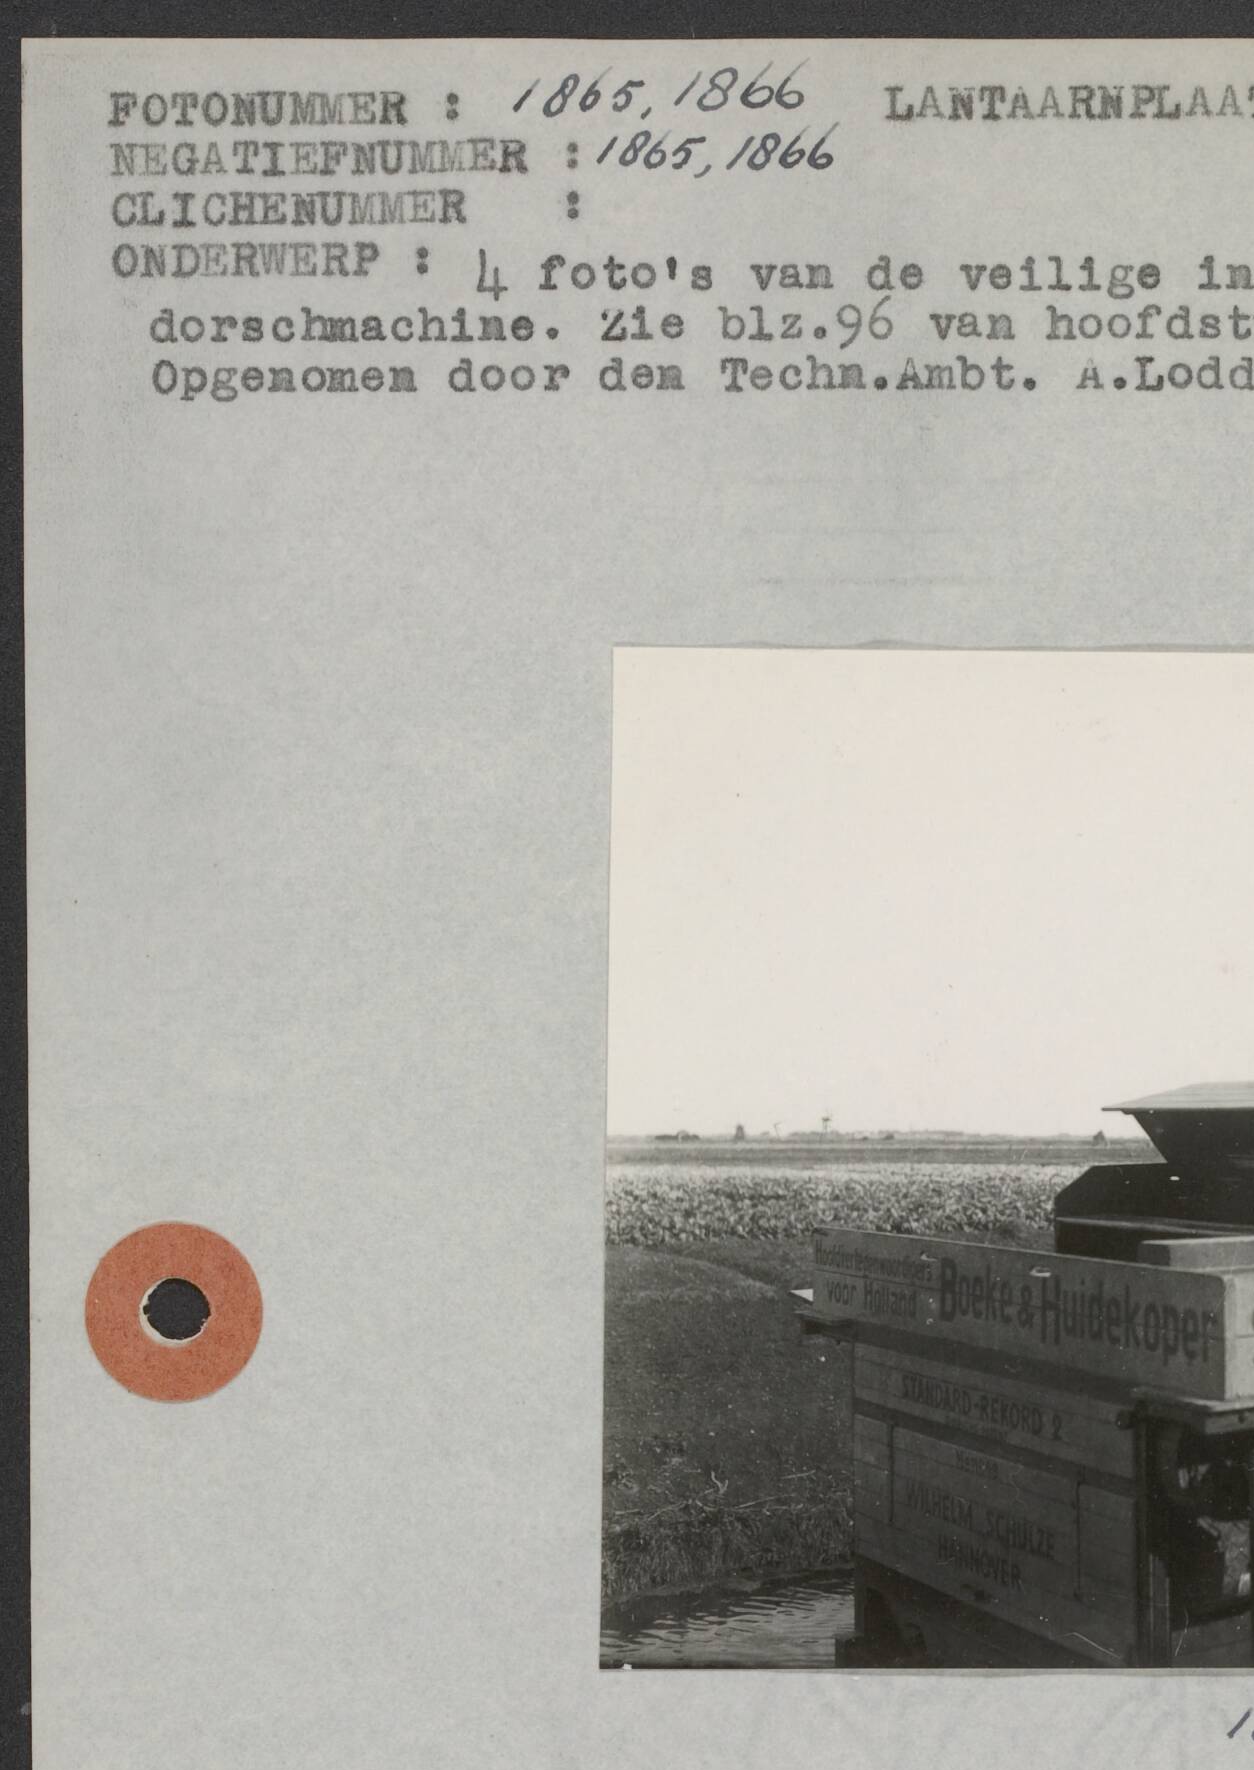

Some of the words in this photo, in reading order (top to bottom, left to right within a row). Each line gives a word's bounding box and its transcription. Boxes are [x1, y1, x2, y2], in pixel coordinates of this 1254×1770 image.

[107, 90, 409, 128] FOTONUMMER
[445, 92, 460, 121] :
[512, 73, 652, 121] 1865,
[673, 58, 807, 113] 1866
[109, 137, 529, 178] NEGATIEFNUMMER
[566, 141, 579, 170] :
[595, 129, 712, 179] 1865,
[725, 122, 839, 172] 1866
[111, 188, 467, 229] CLICHENUMMER
[566, 190, 580, 220] :
[111, 241, 380, 279] ONDERWERP
[415, 245, 429, 276] :
[476, 248, 509, 302] 4
[538, 254, 713, 292] foto's
[749, 263, 835, 292] van
[866, 254, 924, 292] de
[959, 255, 1161, 300] veilige
[149, 306, 560, 344] dorschmachine.
[600, 304, 685, 343] Zie
[717, 294, 894, 350] blz.96
[928, 311, 1016, 341] van
[151, 359, 418, 403] Opgenomen
[447, 357, 571, 393] door
[598, 356, 686, 392] den
[720, 354, 1037, 393] Techn.Ambt.
[826, 1279, 857, 1307] voor
[938, 1256, 1012, 1324] Boeke
[1017, 1281, 1036, 1328] &
[1040, 1275, 1219, 1368] Huidekoper
